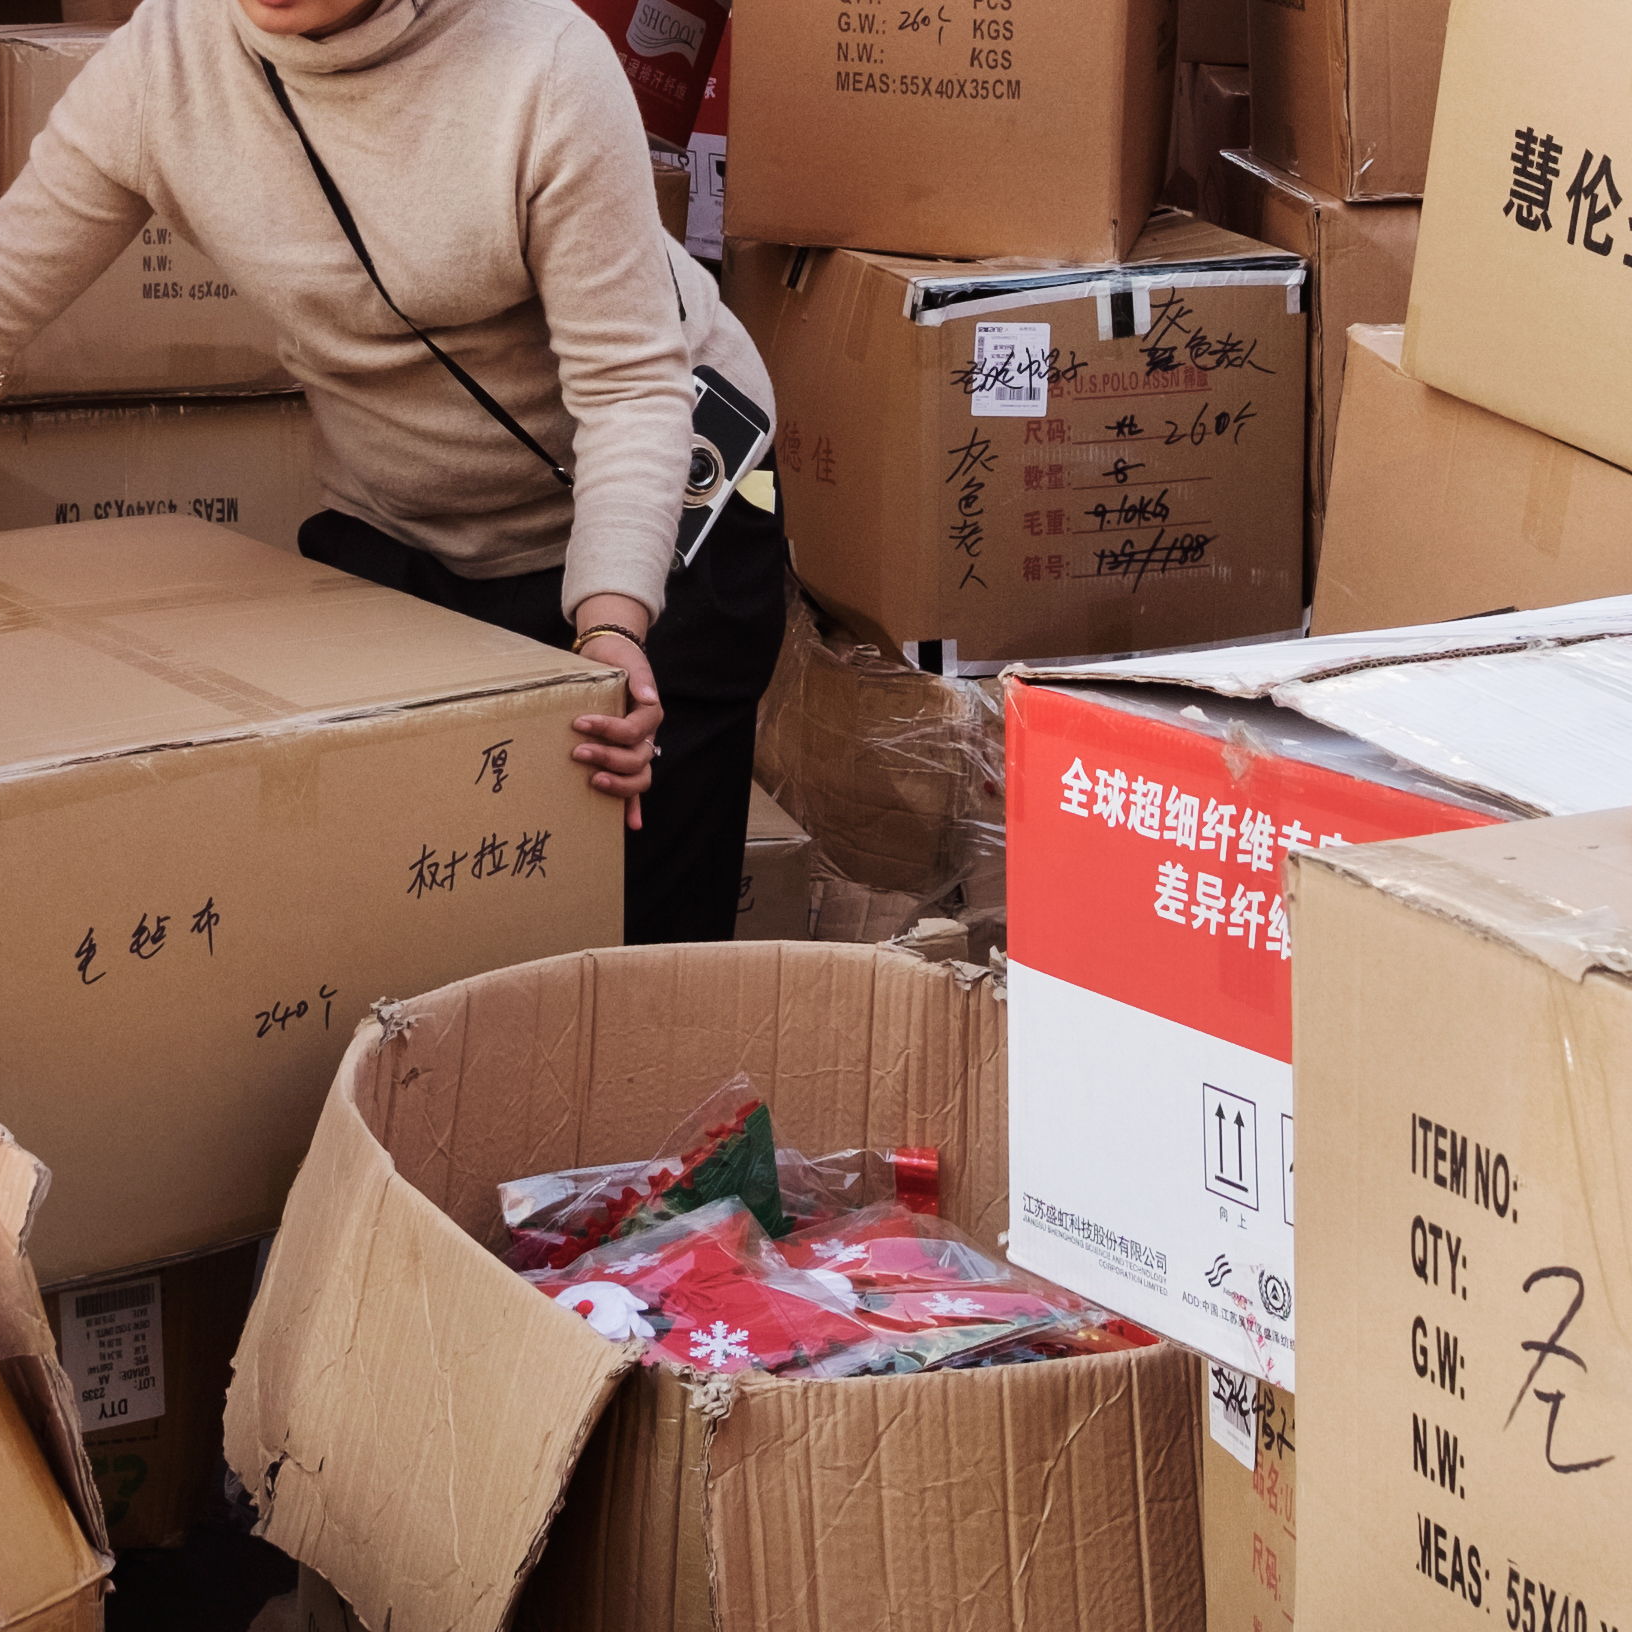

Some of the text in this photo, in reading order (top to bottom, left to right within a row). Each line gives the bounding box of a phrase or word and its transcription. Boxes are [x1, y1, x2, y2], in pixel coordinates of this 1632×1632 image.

[638, 2, 698, 52] SHCOOL
[972, 18, 1014, 41] KGS
[969, 46, 1013, 70] KGS
[142, 228, 172, 246] G.W:
[142, 255, 172, 272] N.W:
[142, 282, 184, 300] MEAS:
[1073, 370, 1140, 395] U.S.POLO
[1142, 368, 1180, 391] ASSN
[1023, 418, 1072, 446] 尺码:
[187, 496, 240, 523] MEAS:
[1022, 509, 1071, 537] 毛重:
[1022, 555, 1071, 582] 箱号:
[1410, 1112, 1519, 1225] ITEM NO:
[1219, 1204, 1248, 1231] 向上
[1022, 1191, 1168, 1276] 江苏盛虹科技股份有限公司
[1410, 1214, 1467, 1301] QTY:
[1097, 1258, 1169, 1297] CORPORATION LIMITED
[1411, 1315, 1466, 1401] G.W:
[133, 1376, 155, 1392] LOT:
[97, 1398, 128, 1420] DTY
[1412, 1412, 1466, 1500] N.W:
[1415, 1511, 1492, 1615] MEAS:
